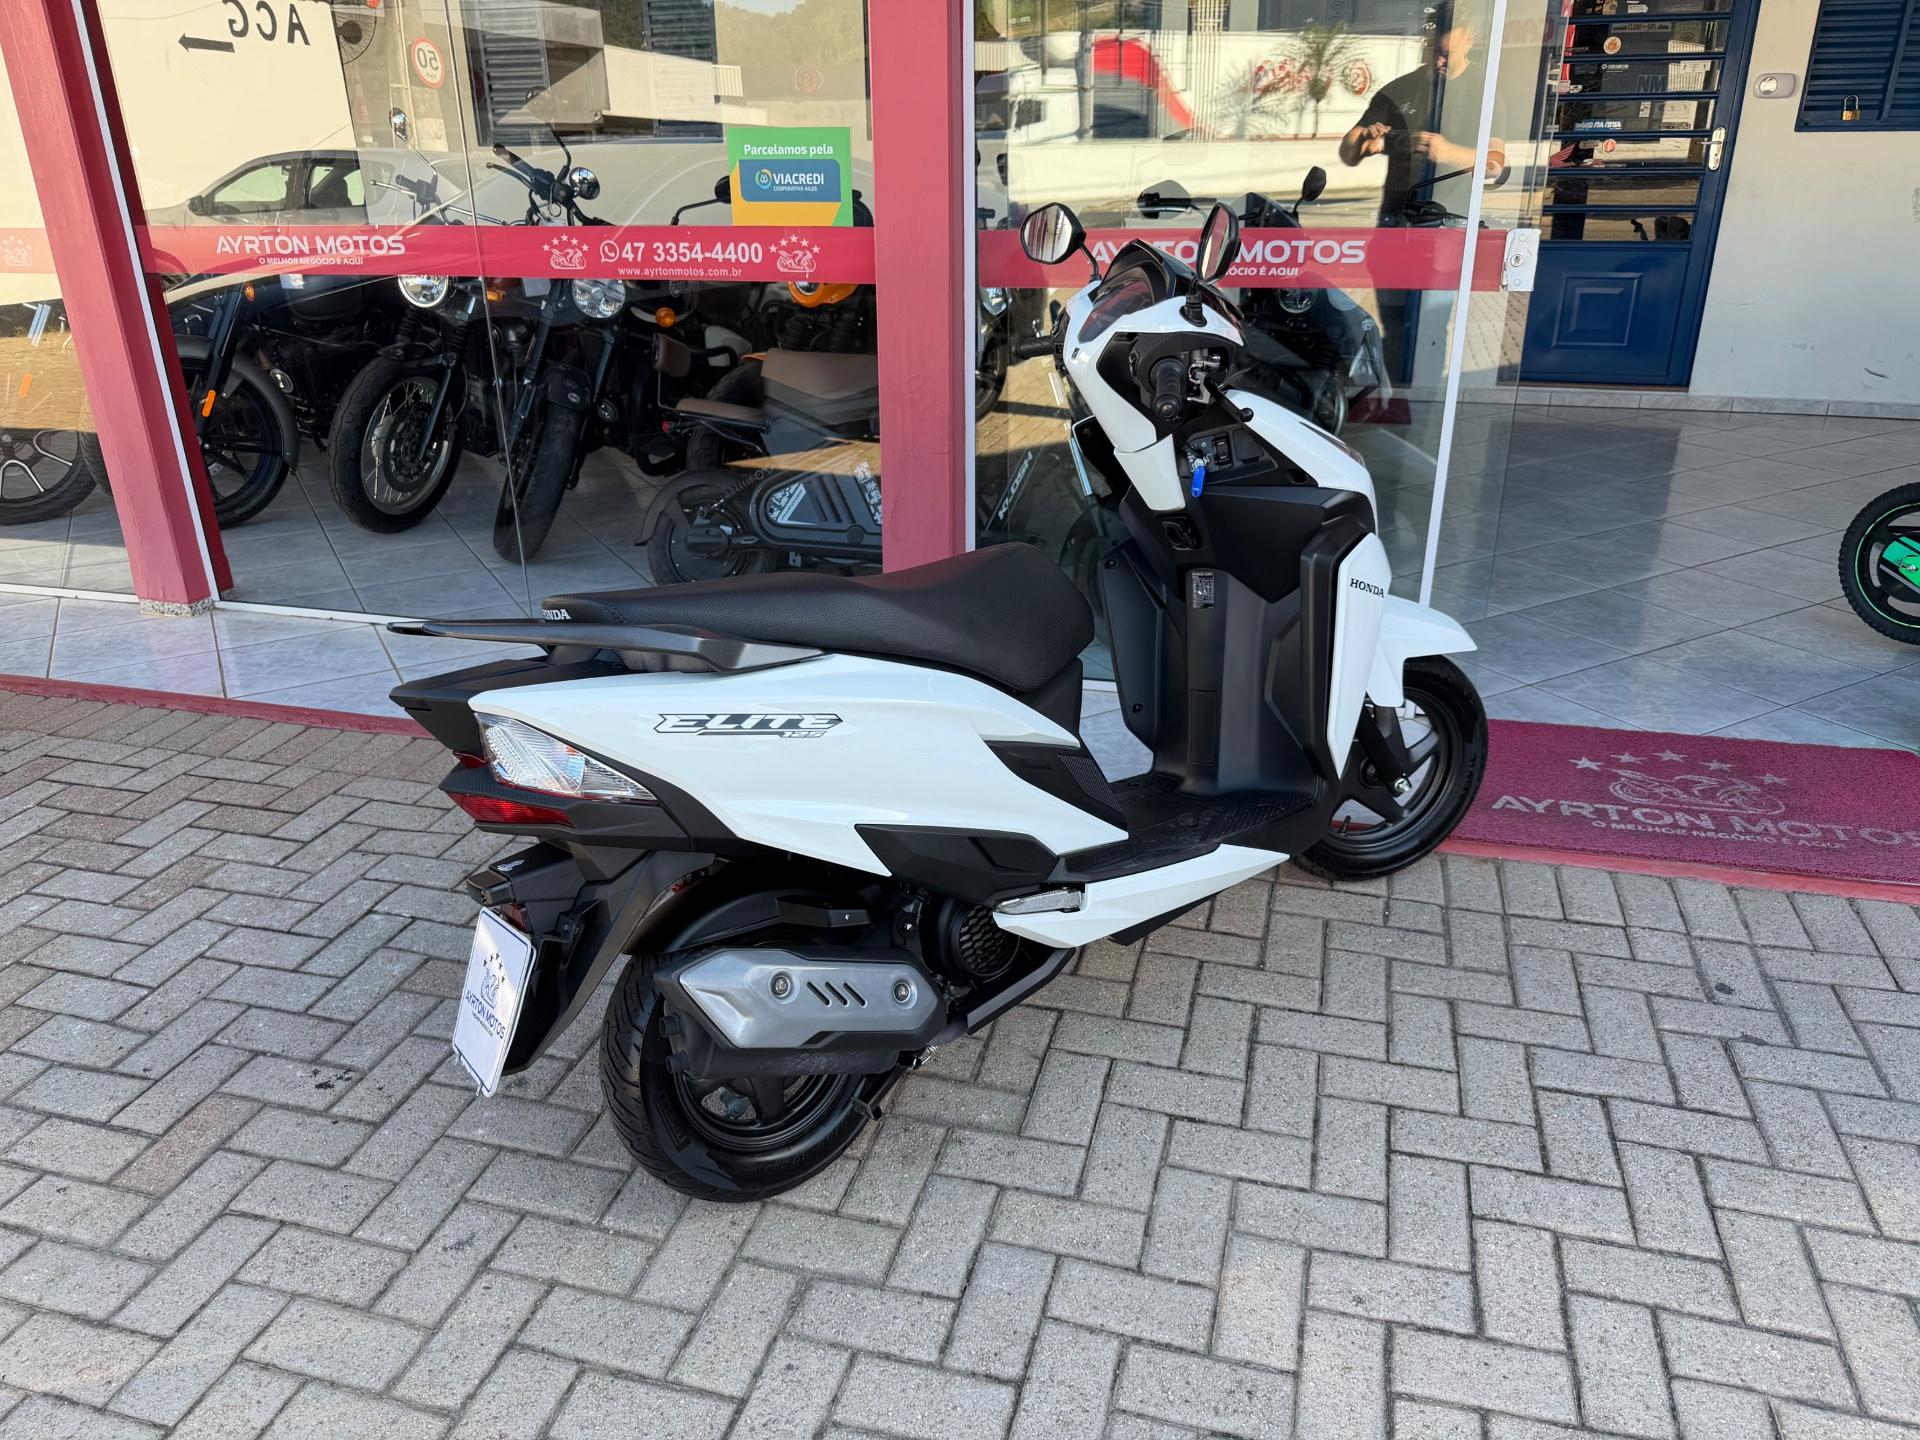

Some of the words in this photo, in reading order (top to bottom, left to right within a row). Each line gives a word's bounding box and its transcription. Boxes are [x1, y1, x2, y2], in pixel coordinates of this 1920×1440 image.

[744, 144, 806, 155] Parcelamos
[810, 144, 833, 156] pela
[773, 173, 824, 185] VIACREDI
[216, 235, 309, 254] AYRTON
[315, 235, 406, 255] MOTOS
[621, 242, 645, 262] 47
[653, 242, 763, 263] 3354-4400
[1235, 240, 1366, 263] MOTOS
[259, 257, 266, 265] O
[267, 257, 299, 265] MELHOR
[300, 256, 336, 265] NEGÓCIO
[343, 257, 363, 266] AQUI
[618, 267, 742, 277] www.ayrtonmotos.com.br
[1225, 265, 1257, 276] ÓCIO
[1260, 265, 1267, 276] É
[1268, 267, 1299, 276] AQUI
[1350, 578, 1384, 598] HONDA
[542, 608, 571, 620] NDA
[781, 730, 826, 738] 125
[1491, 794, 1715, 829] AYRTON
[1592, 820, 1606, 828] O
[465, 990, 487, 1018] AYRTON
[486, 1009, 506, 1040] MOTOS
